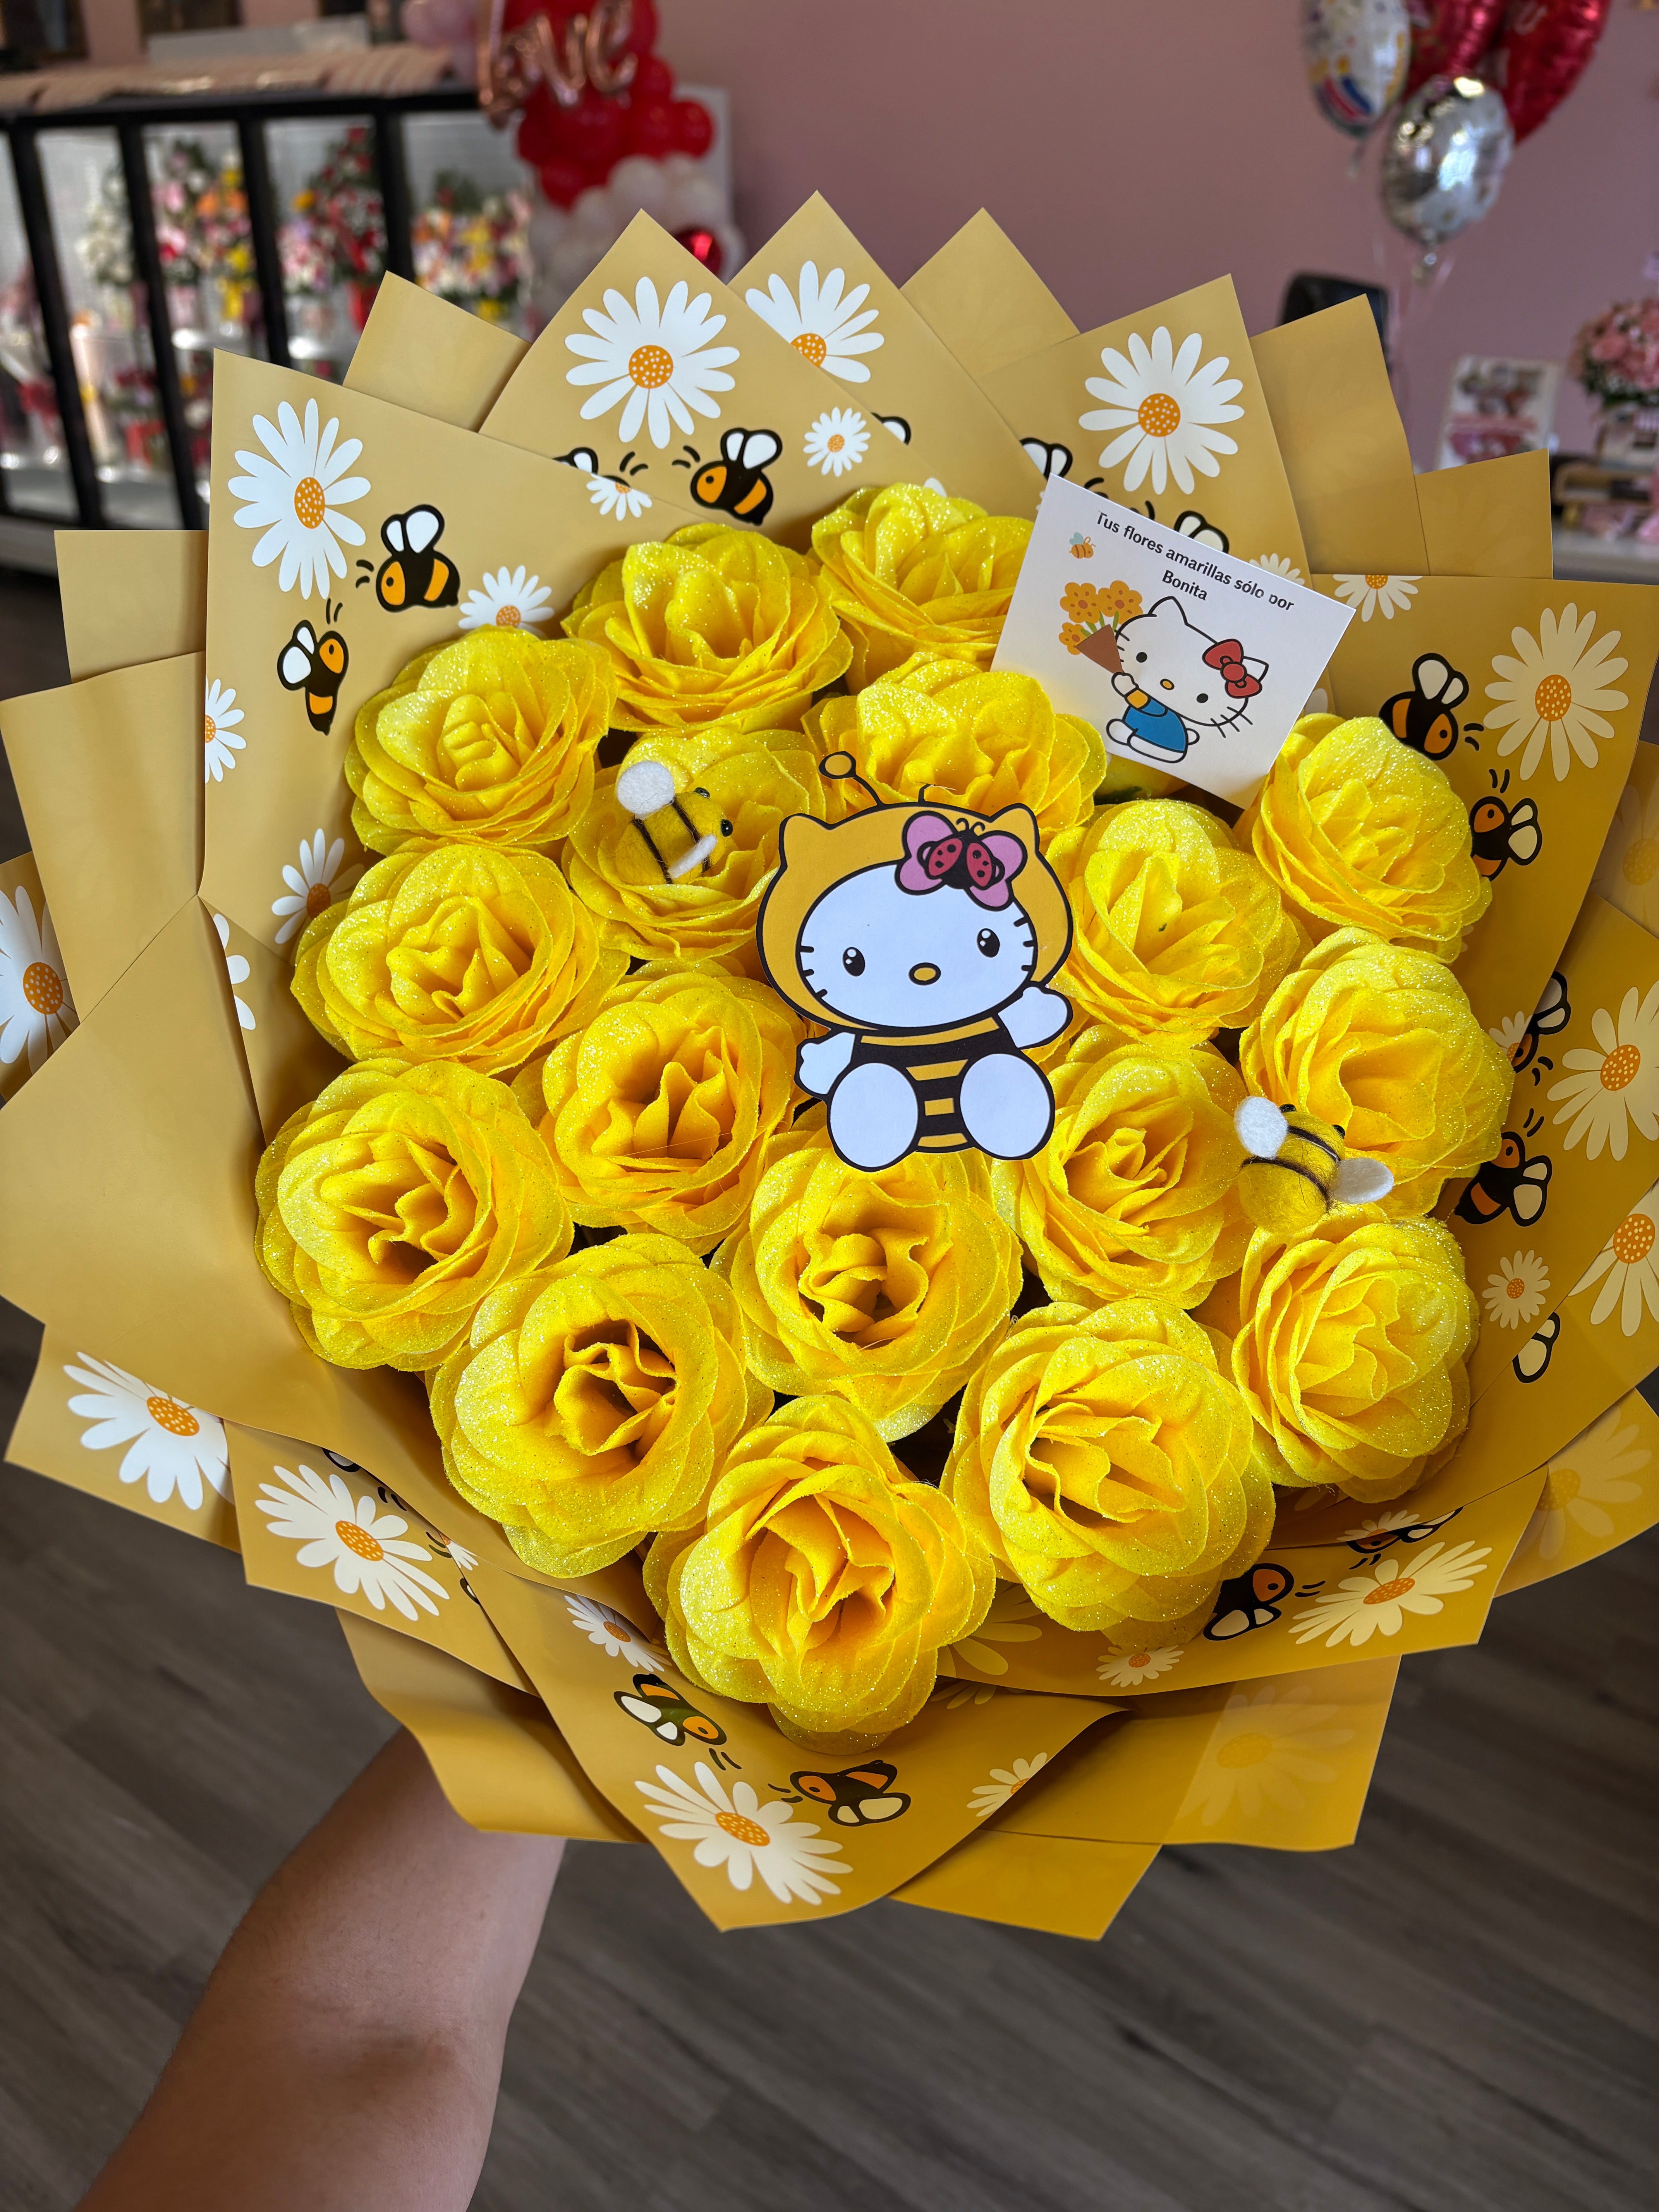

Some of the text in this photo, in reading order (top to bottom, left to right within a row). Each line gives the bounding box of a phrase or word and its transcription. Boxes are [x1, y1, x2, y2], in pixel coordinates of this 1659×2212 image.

[1097, 510, 1120, 533] Tus
[1123, 525, 1163, 554] flores
[1166, 549, 1232, 585] amarillas
[1234, 580, 1265, 598] sólo
[1162, 570, 1207, 601] Bonita
